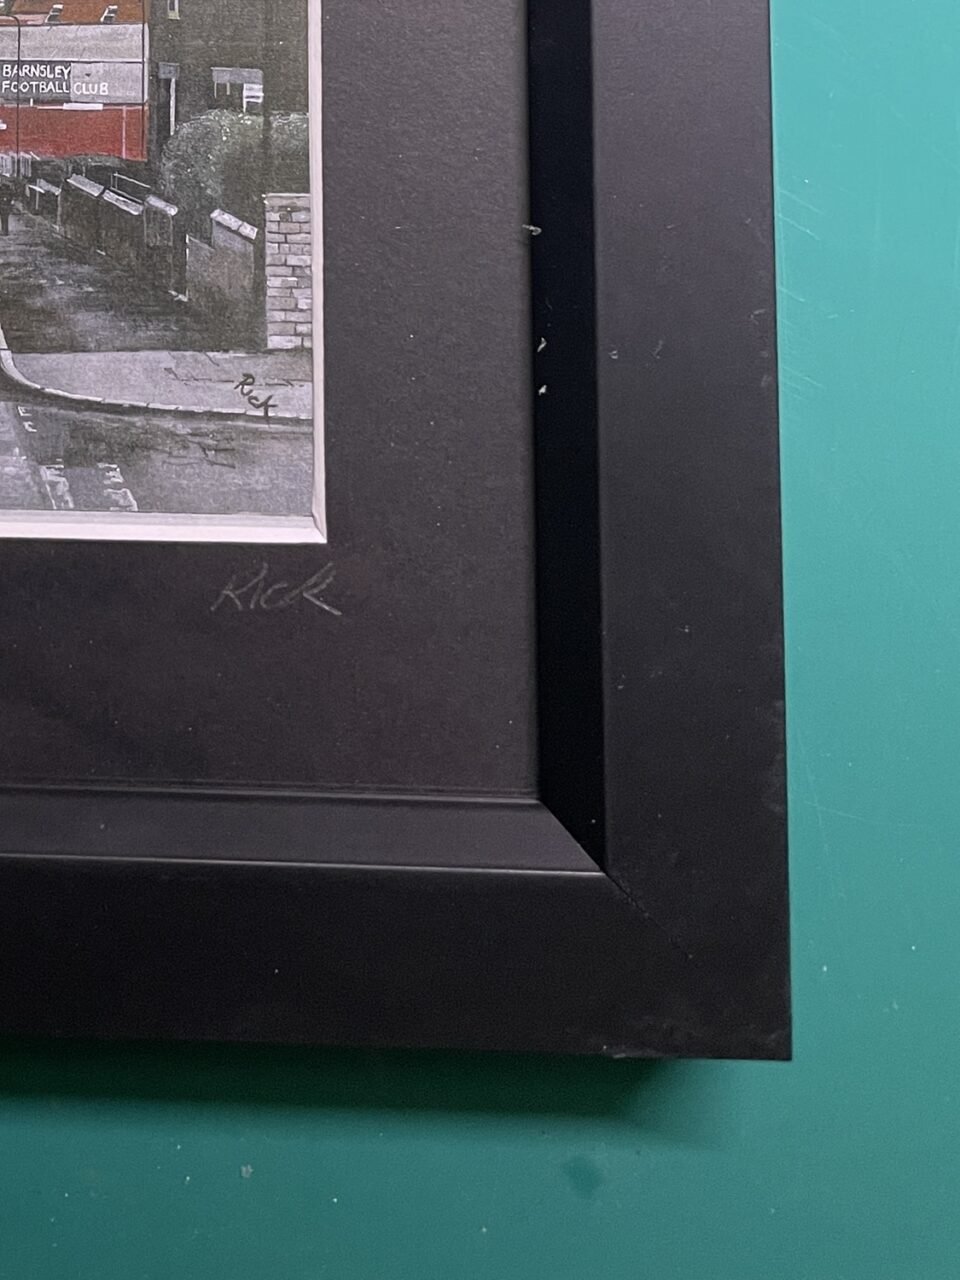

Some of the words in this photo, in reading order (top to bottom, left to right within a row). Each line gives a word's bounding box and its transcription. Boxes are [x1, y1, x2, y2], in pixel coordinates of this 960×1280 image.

[2, 64, 71, 79] BARNSLEY
[2, 81, 70, 94] FOOTBALL
[73, 82, 109, 96] CLUB
